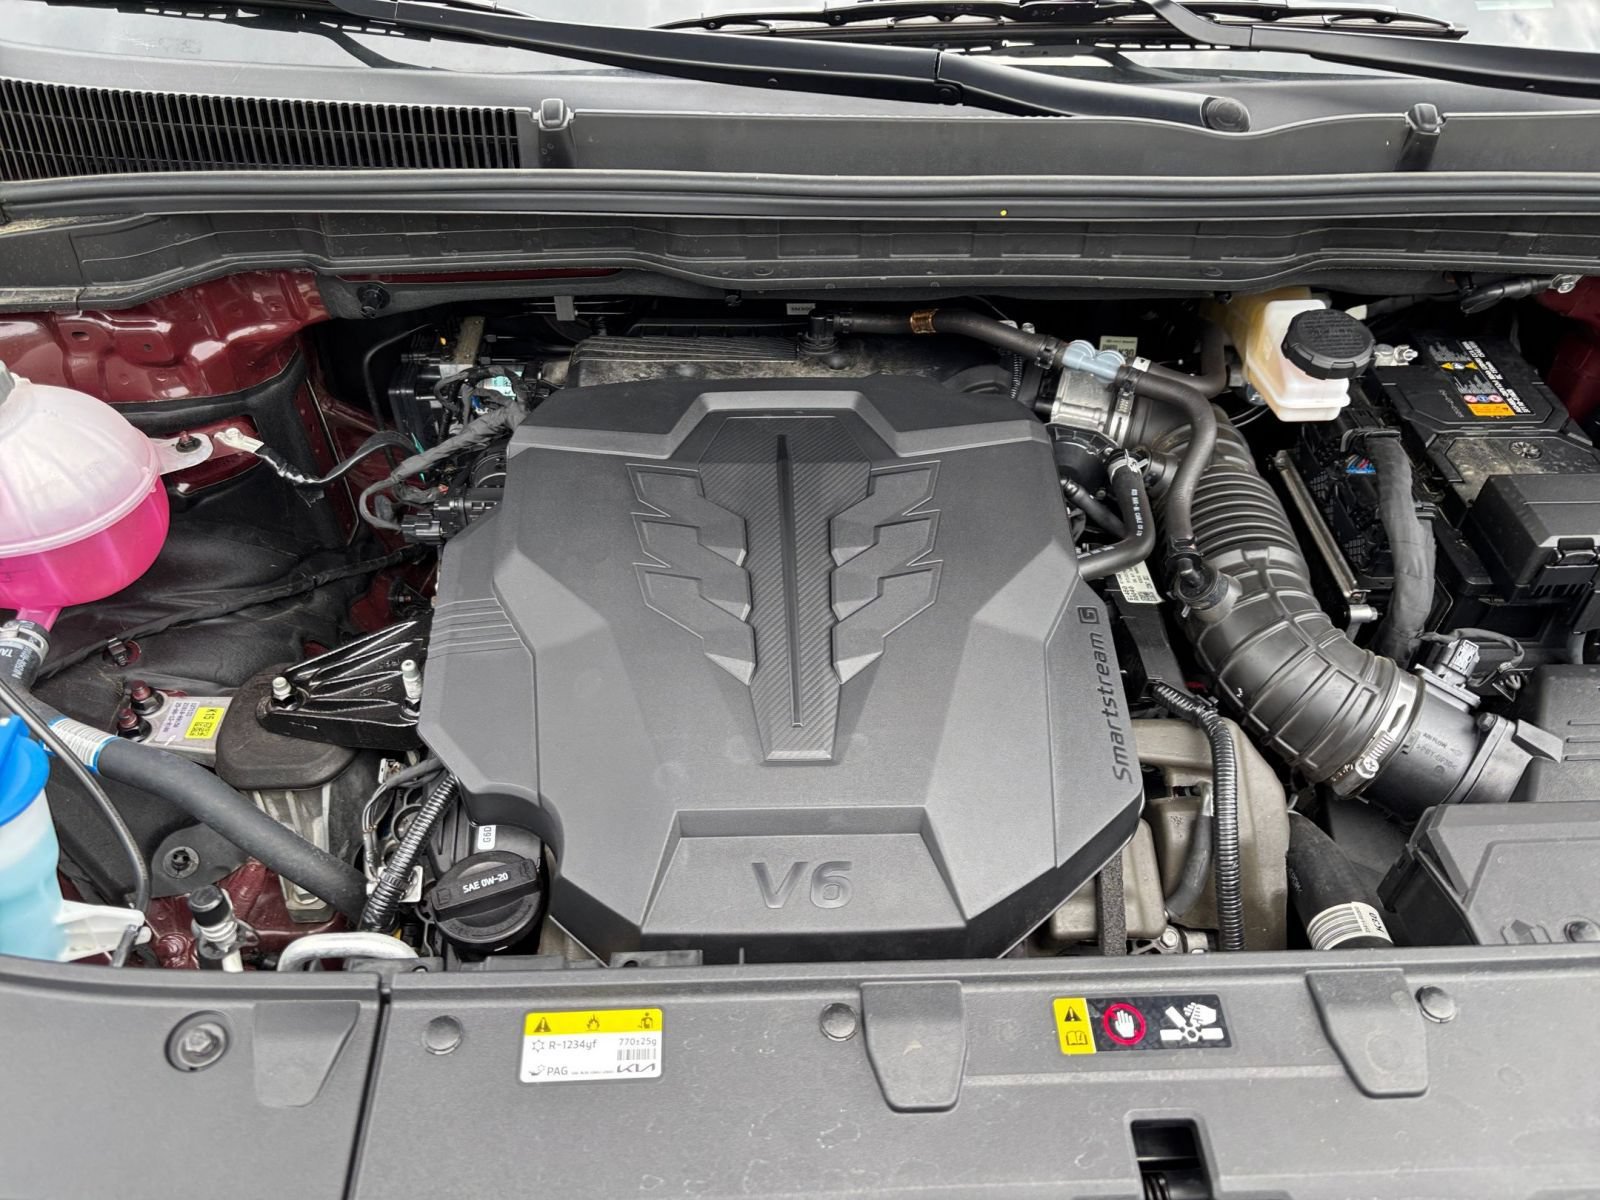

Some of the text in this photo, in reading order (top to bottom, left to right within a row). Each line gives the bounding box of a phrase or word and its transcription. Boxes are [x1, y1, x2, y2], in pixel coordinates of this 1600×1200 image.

[1091, 632, 1132, 784] Smartstream
[482, 826, 492, 842] G6D
[462, 872, 509, 894] SAE 0W-20
[751, 860, 853, 910] V6
[548, 1039, 598, 1050] R-1234yf
[546, 1066, 568, 1076] PAG
